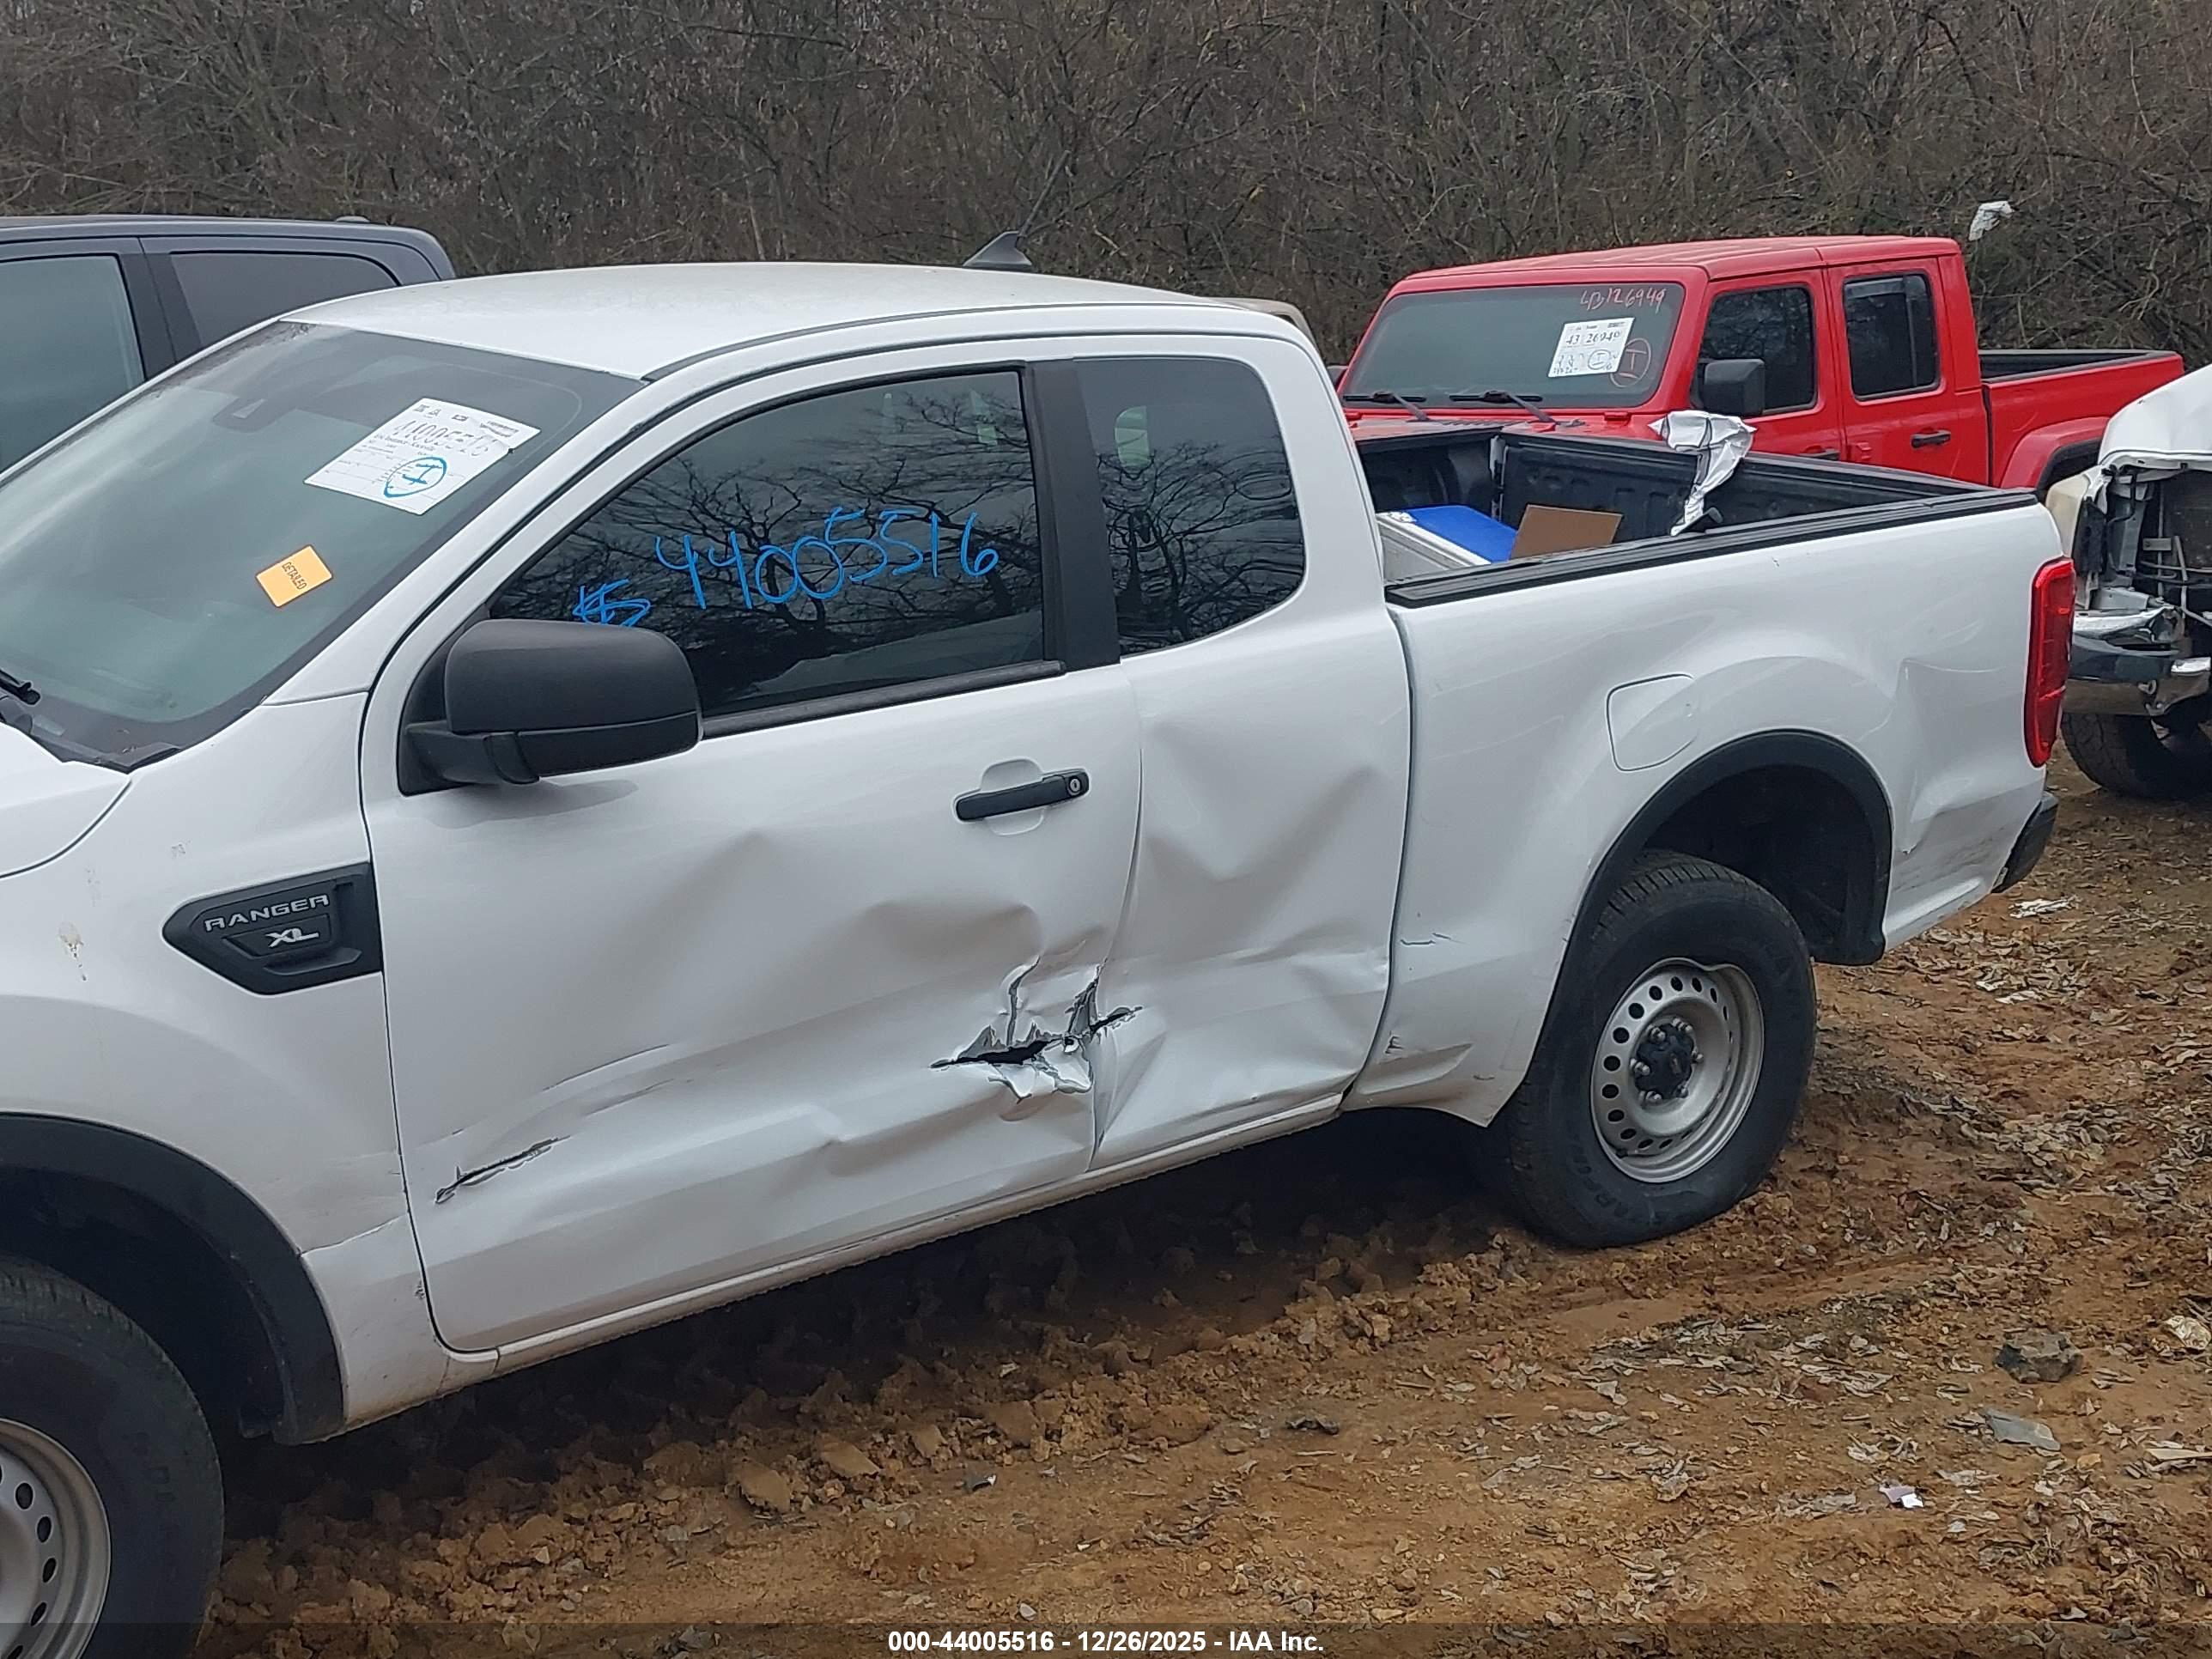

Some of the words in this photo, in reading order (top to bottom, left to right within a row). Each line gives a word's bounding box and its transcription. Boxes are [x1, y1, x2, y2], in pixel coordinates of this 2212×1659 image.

[655, 507, 1000, 611] 44005516
[204, 894, 331, 933] RANGER
[265, 927, 319, 948] XL
